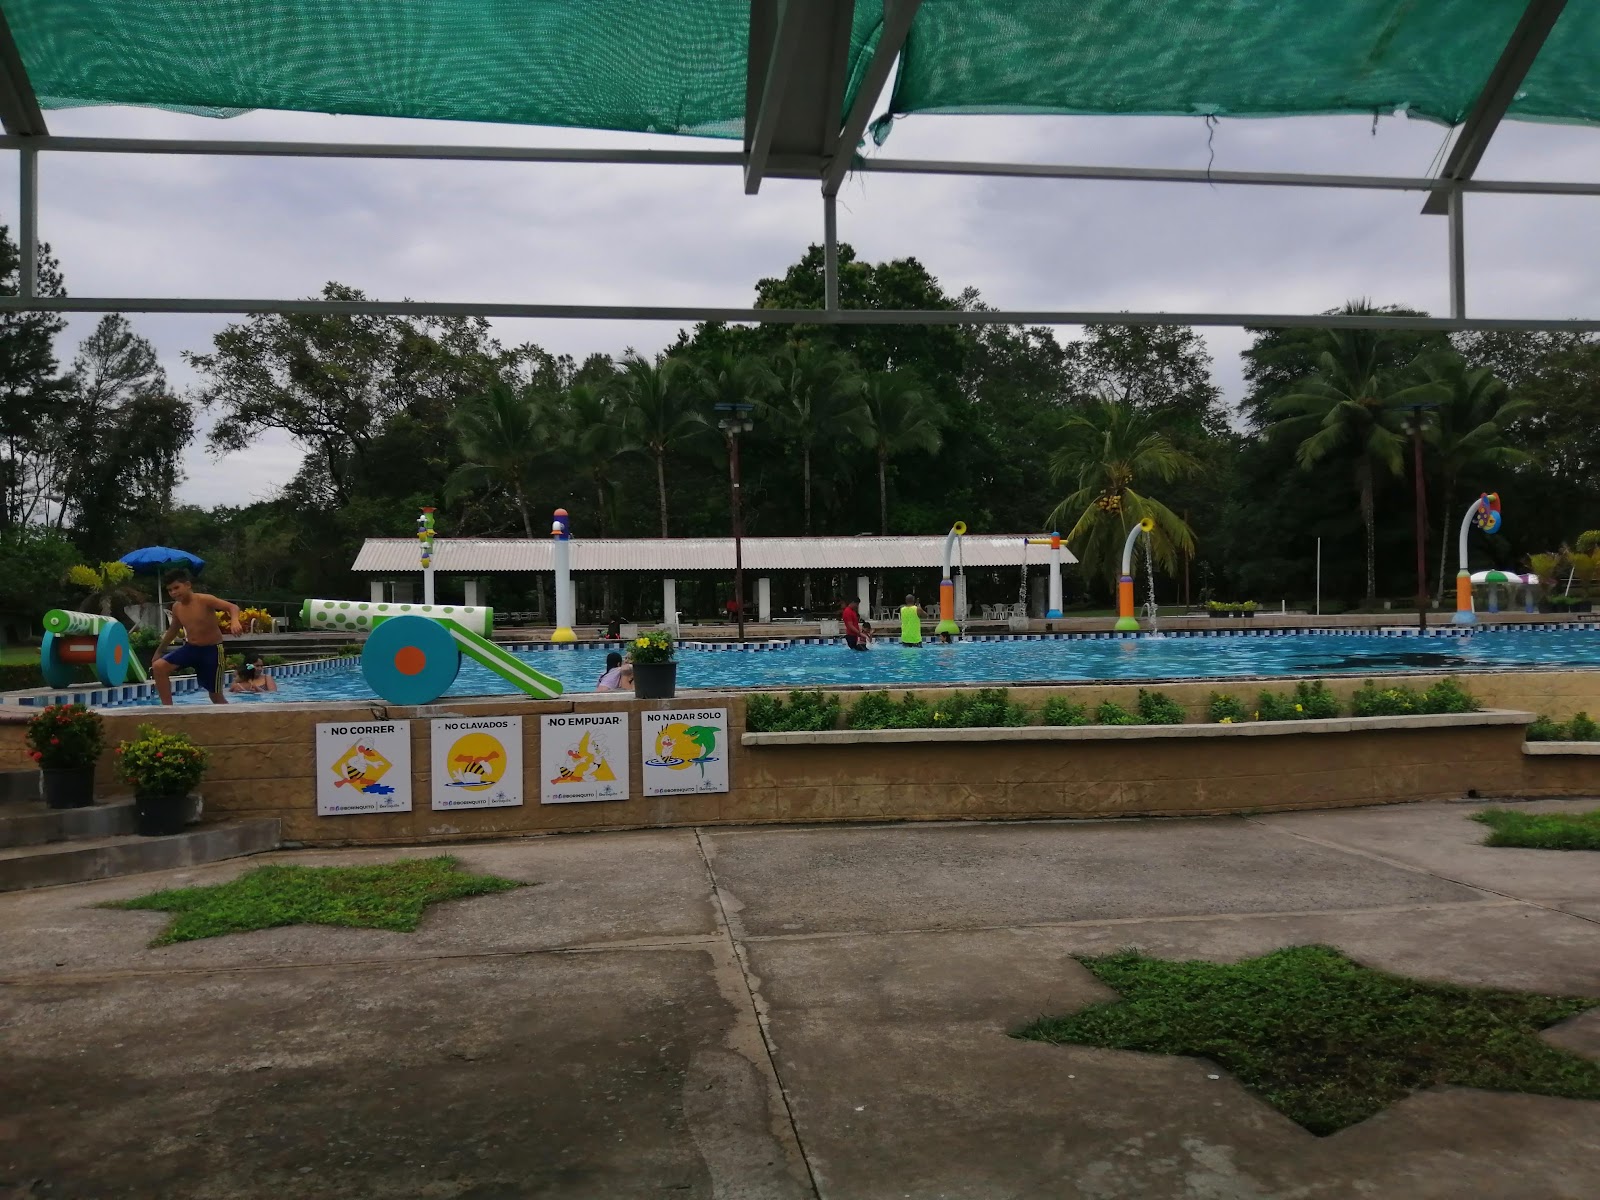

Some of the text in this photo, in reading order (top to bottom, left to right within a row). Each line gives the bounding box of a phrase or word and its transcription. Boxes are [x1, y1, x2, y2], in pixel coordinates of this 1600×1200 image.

[549, 716, 620, 726] NO EMPUJAR
[662, 713, 696, 721] NADAR
[697, 712, 722, 720] SOLO
[460, 721, 508, 730] CLAVADOS
[331, 725, 395, 736] NO CORRER
